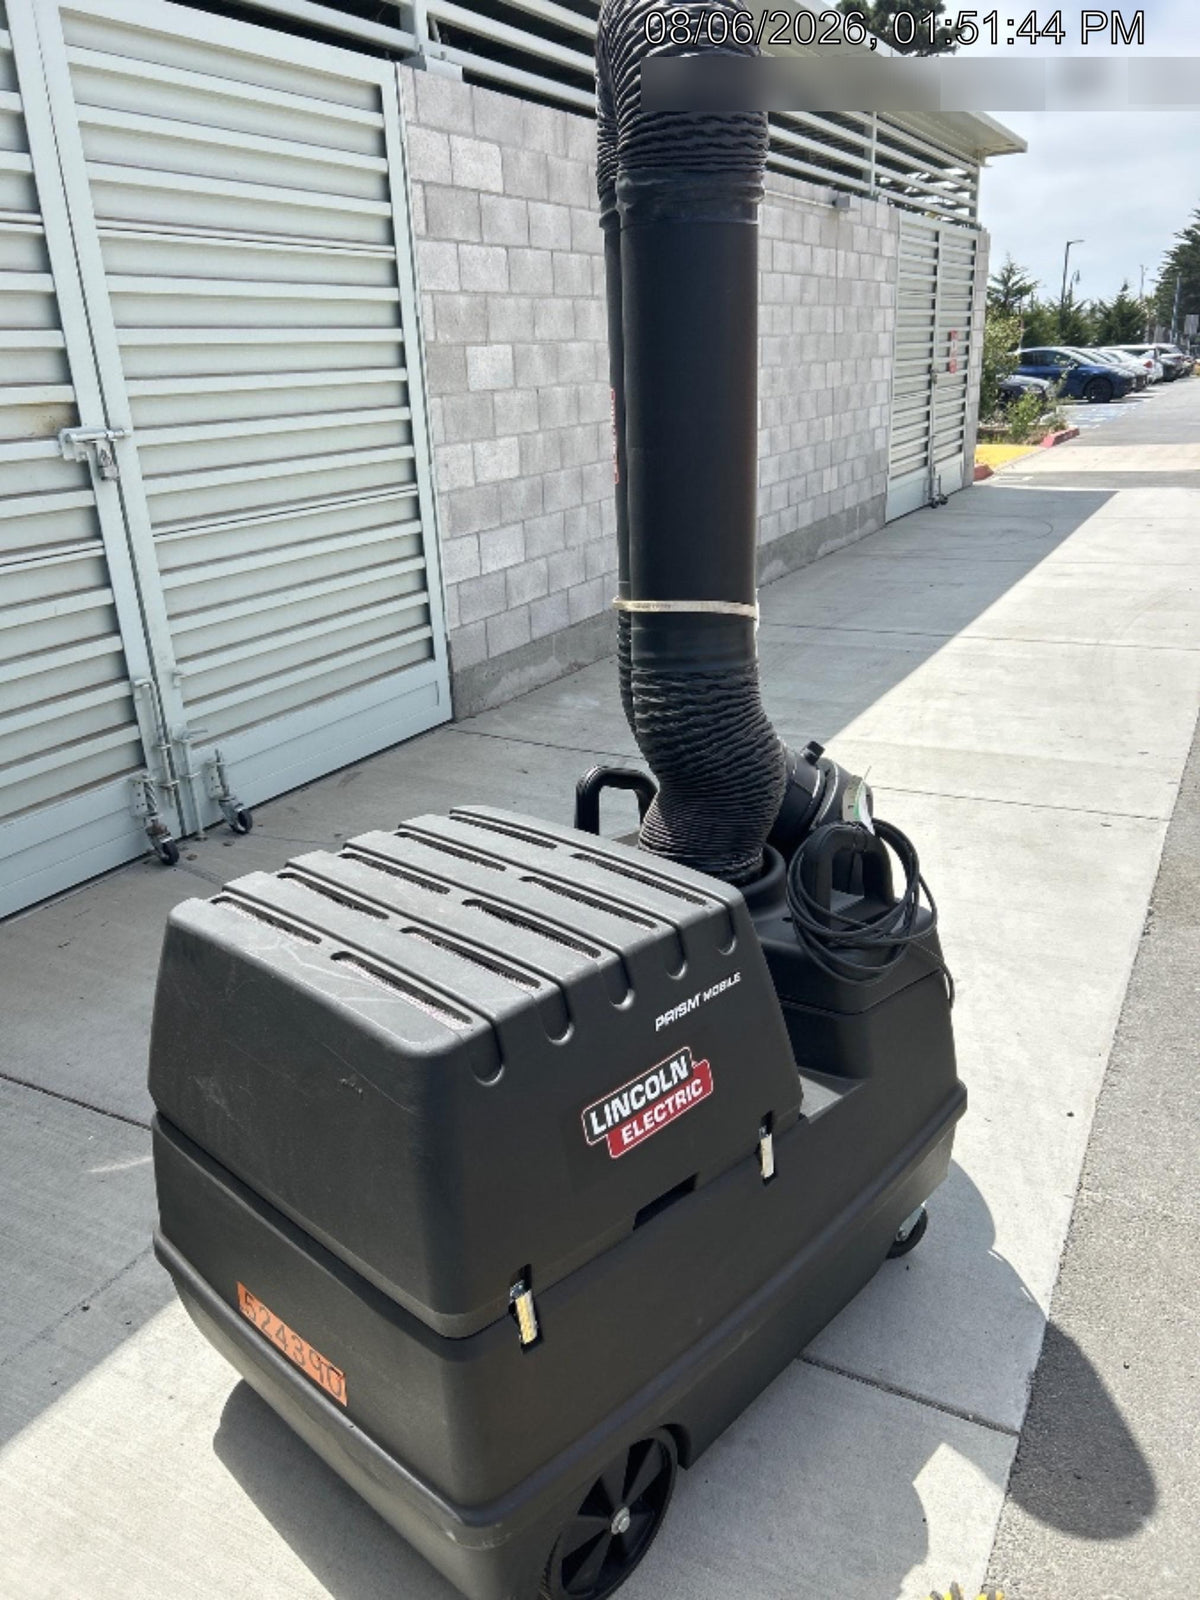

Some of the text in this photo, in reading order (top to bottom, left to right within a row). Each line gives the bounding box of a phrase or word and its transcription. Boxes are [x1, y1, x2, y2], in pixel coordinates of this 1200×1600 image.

[703, 971, 741, 1002] MOBILE
[589, 1055, 690, 1135] LINCOLN
[620, 1078, 704, 1145] ELECTRIC
[240, 1290, 344, 1397] 524390
